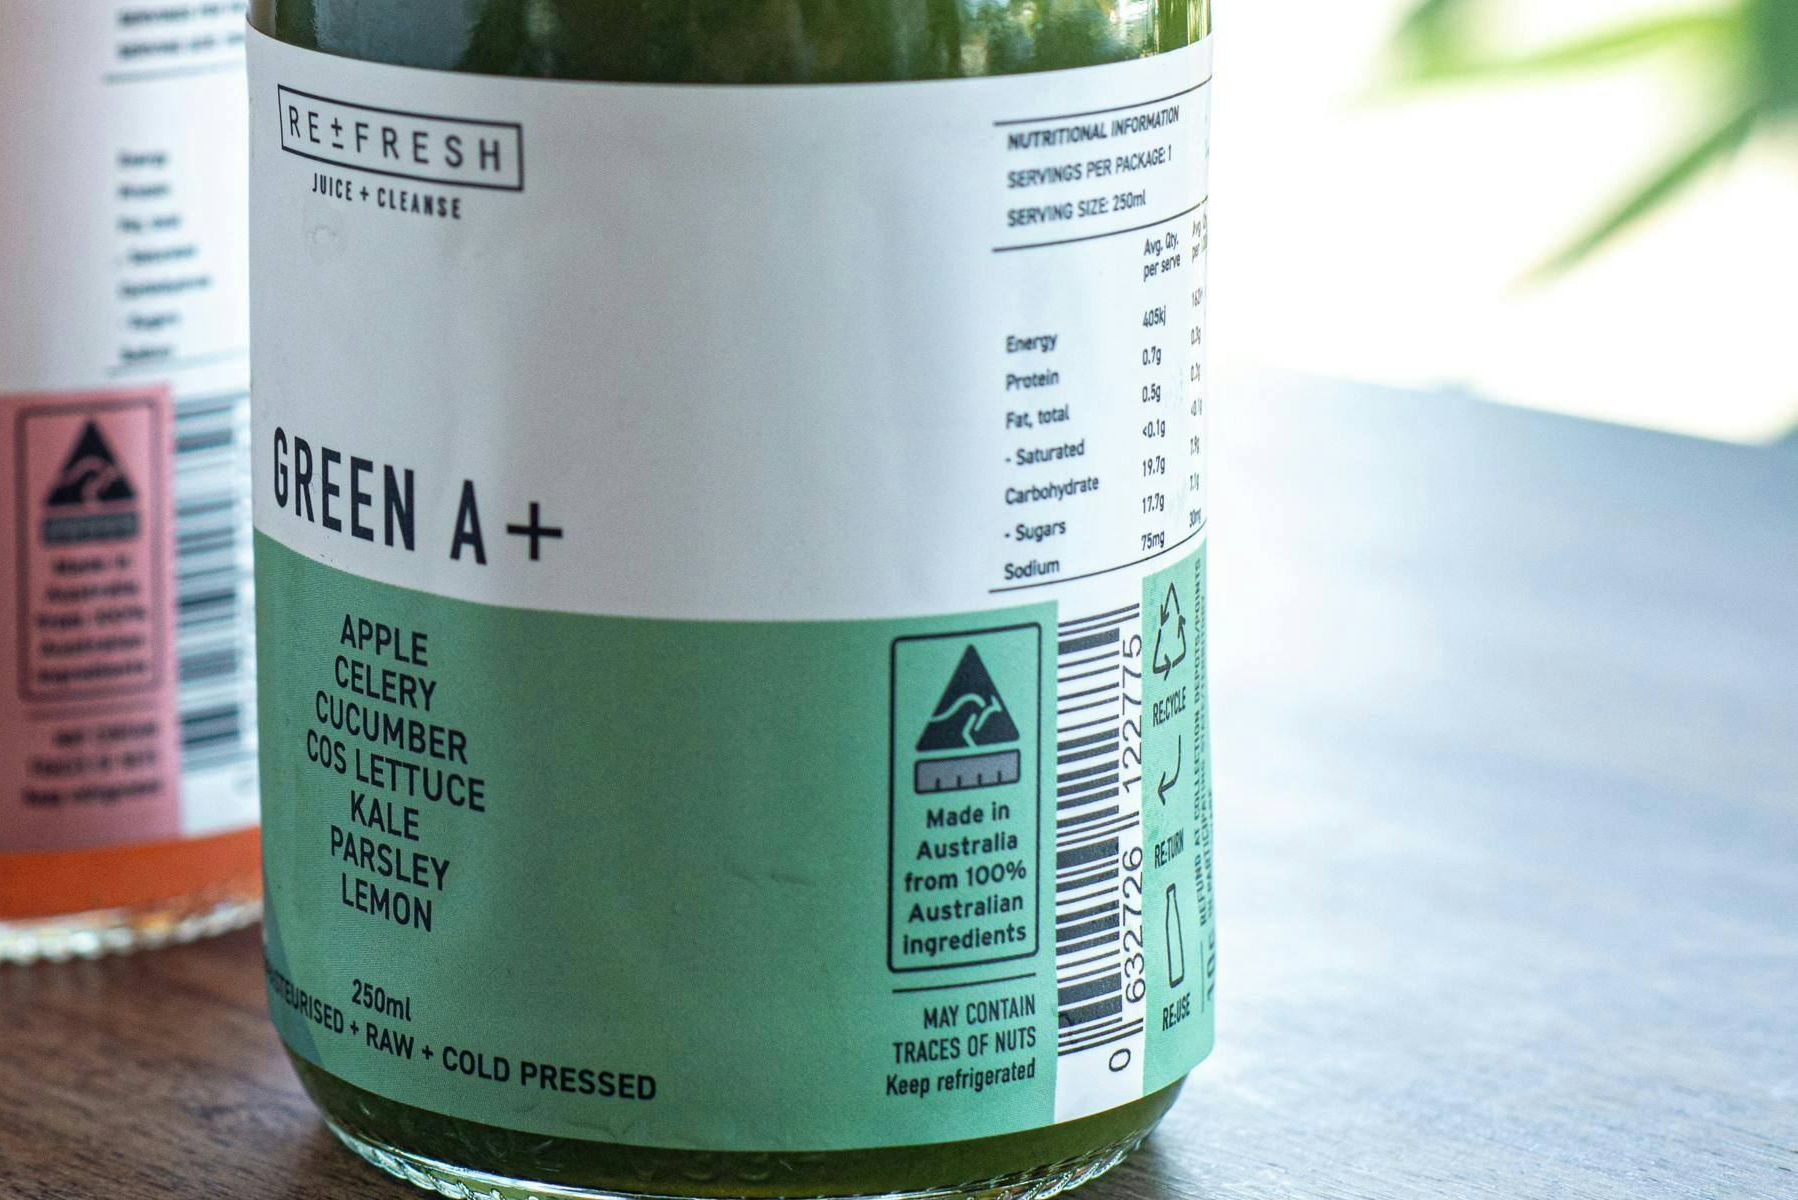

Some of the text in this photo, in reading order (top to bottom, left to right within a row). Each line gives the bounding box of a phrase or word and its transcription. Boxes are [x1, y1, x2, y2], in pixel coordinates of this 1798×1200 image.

[1007, 122, 1107, 150] NUTRITIONAL
[1111, 105, 1180, 137] INFORMATION
[1007, 163, 1082, 189] SERVINGS
[1086, 159, 1112, 179] PER
[312, 173, 352, 201] JUICE
[377, 188, 462, 220] CLEANSE
[1007, 189, 1146, 228] SERVING SIZE: 250ml
[1143, 231, 1179, 256] Avg. Qty.
[1143, 253, 1181, 282] per serve
[1005, 333, 1058, 353] Energy
[1005, 369, 1060, 391] Protein
[1142, 346, 1162, 366] 0.7g
[1005, 412, 1033, 430] Fat,
[1038, 404, 1070, 426] total
[1142, 384, 1161, 403] 0.5g
[1016, 439, 1085, 466] Saturated
[273, 426, 416, 551] GREEN
[1005, 475, 1099, 506] Carbohydrate
[1142, 455, 1165, 477] 19.7g
[1015, 520, 1067, 543] Sugars
[1142, 492, 1165, 514] 17.7g
[1004, 559, 1060, 581] Sodium
[1141, 531, 1165, 551] 75mg
[340, 614, 428, 667] APPLE
[334, 655, 437, 712] CELERY
[315, 690, 468, 765] CUCUMBER
[1152, 686, 1186, 728] RE:CYCLE
[306, 729, 486, 813] COS LETTUCE
[350, 790, 419, 841] KALE
[926, 801, 1010, 829] Made in
[330, 825, 450, 891] PARSLEY
[916, 832, 1019, 860] Australia
[1109, 633, 1146, 1073] 0 632726 122775
[1154, 828, 1184, 869] RE:TURN
[1194, 829, 1200, 847] AT
[905, 860, 1027, 893] from 100%
[1194, 855, 1207, 927] REFUND
[341, 872, 432, 932] LEMON
[908, 894, 1023, 923] Australian
[903, 923, 1027, 956] ingredients
[352, 978, 411, 1022] 250ml
[923, 994, 1036, 1030] MAY CONTAIN
[1162, 992, 1191, 1032] RE:USE
[366, 1022, 414, 1060] RAW
[442, 1046, 511, 1083] COLD
[520, 1061, 657, 1100] PRESSED
[893, 1025, 1036, 1065] TRACES OF NUTS
[886, 1057, 1036, 1099] Keep refrigerated
